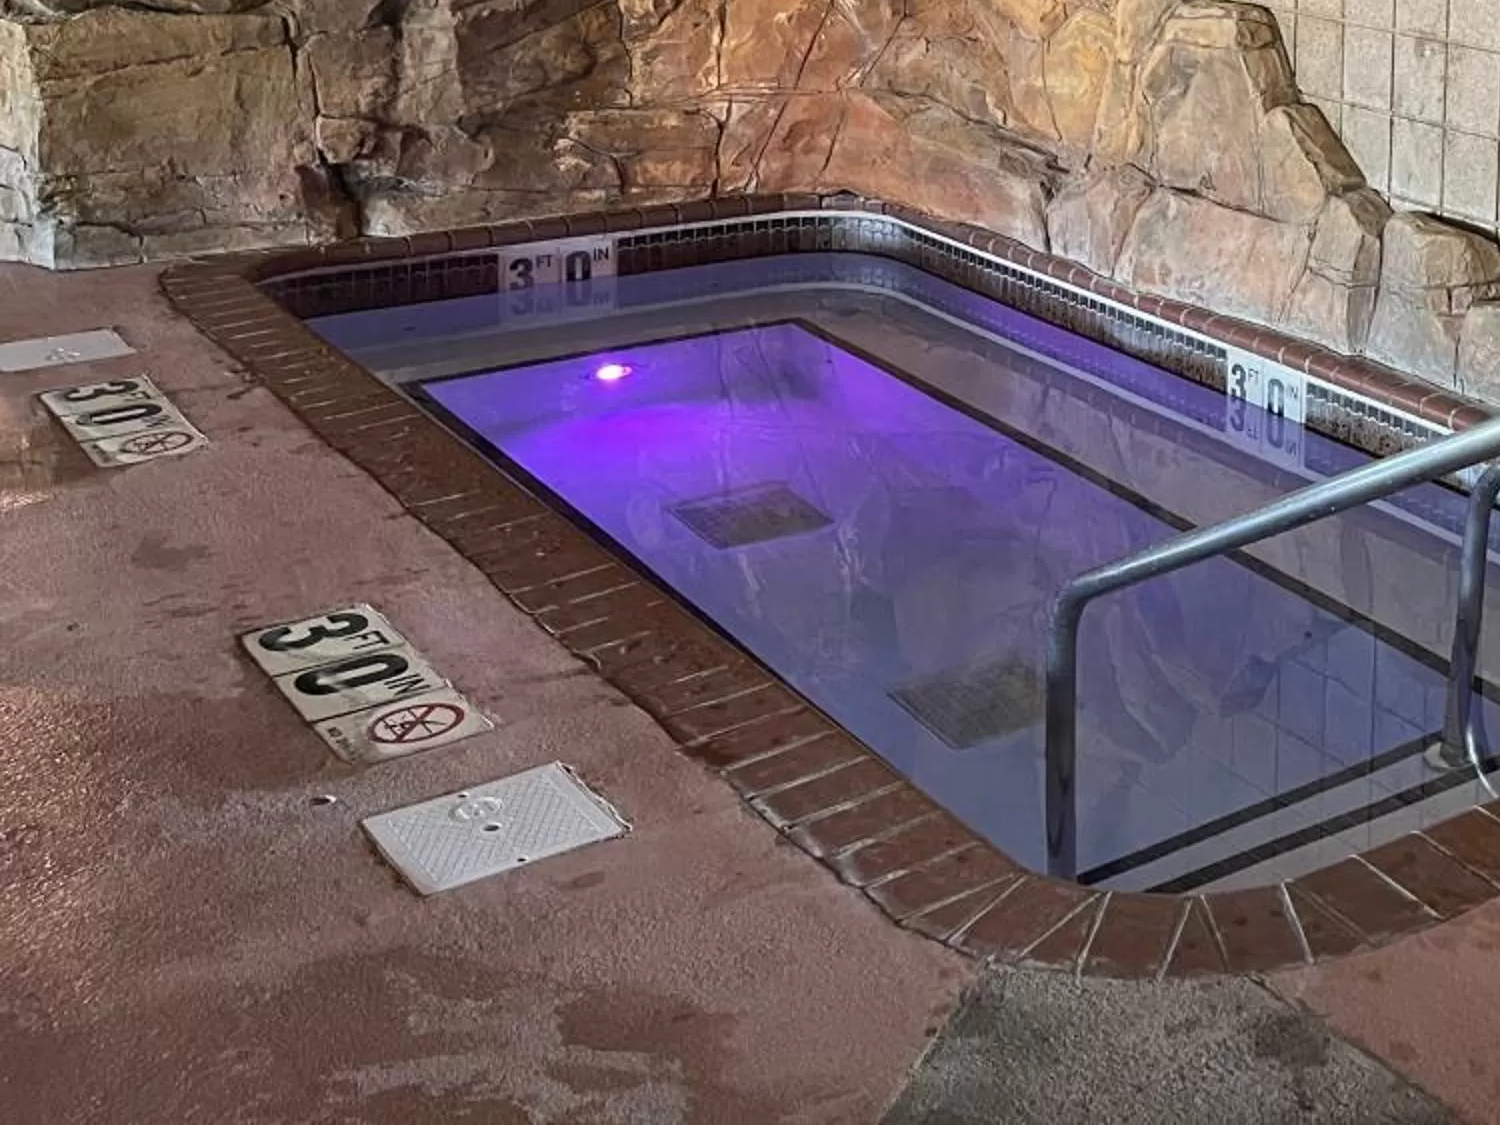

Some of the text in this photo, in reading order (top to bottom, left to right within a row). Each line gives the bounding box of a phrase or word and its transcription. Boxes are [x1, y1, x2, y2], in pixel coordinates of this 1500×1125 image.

[509, 257, 534, 291] 3
[258, 612, 431, 696] 3 FT 0 IN
